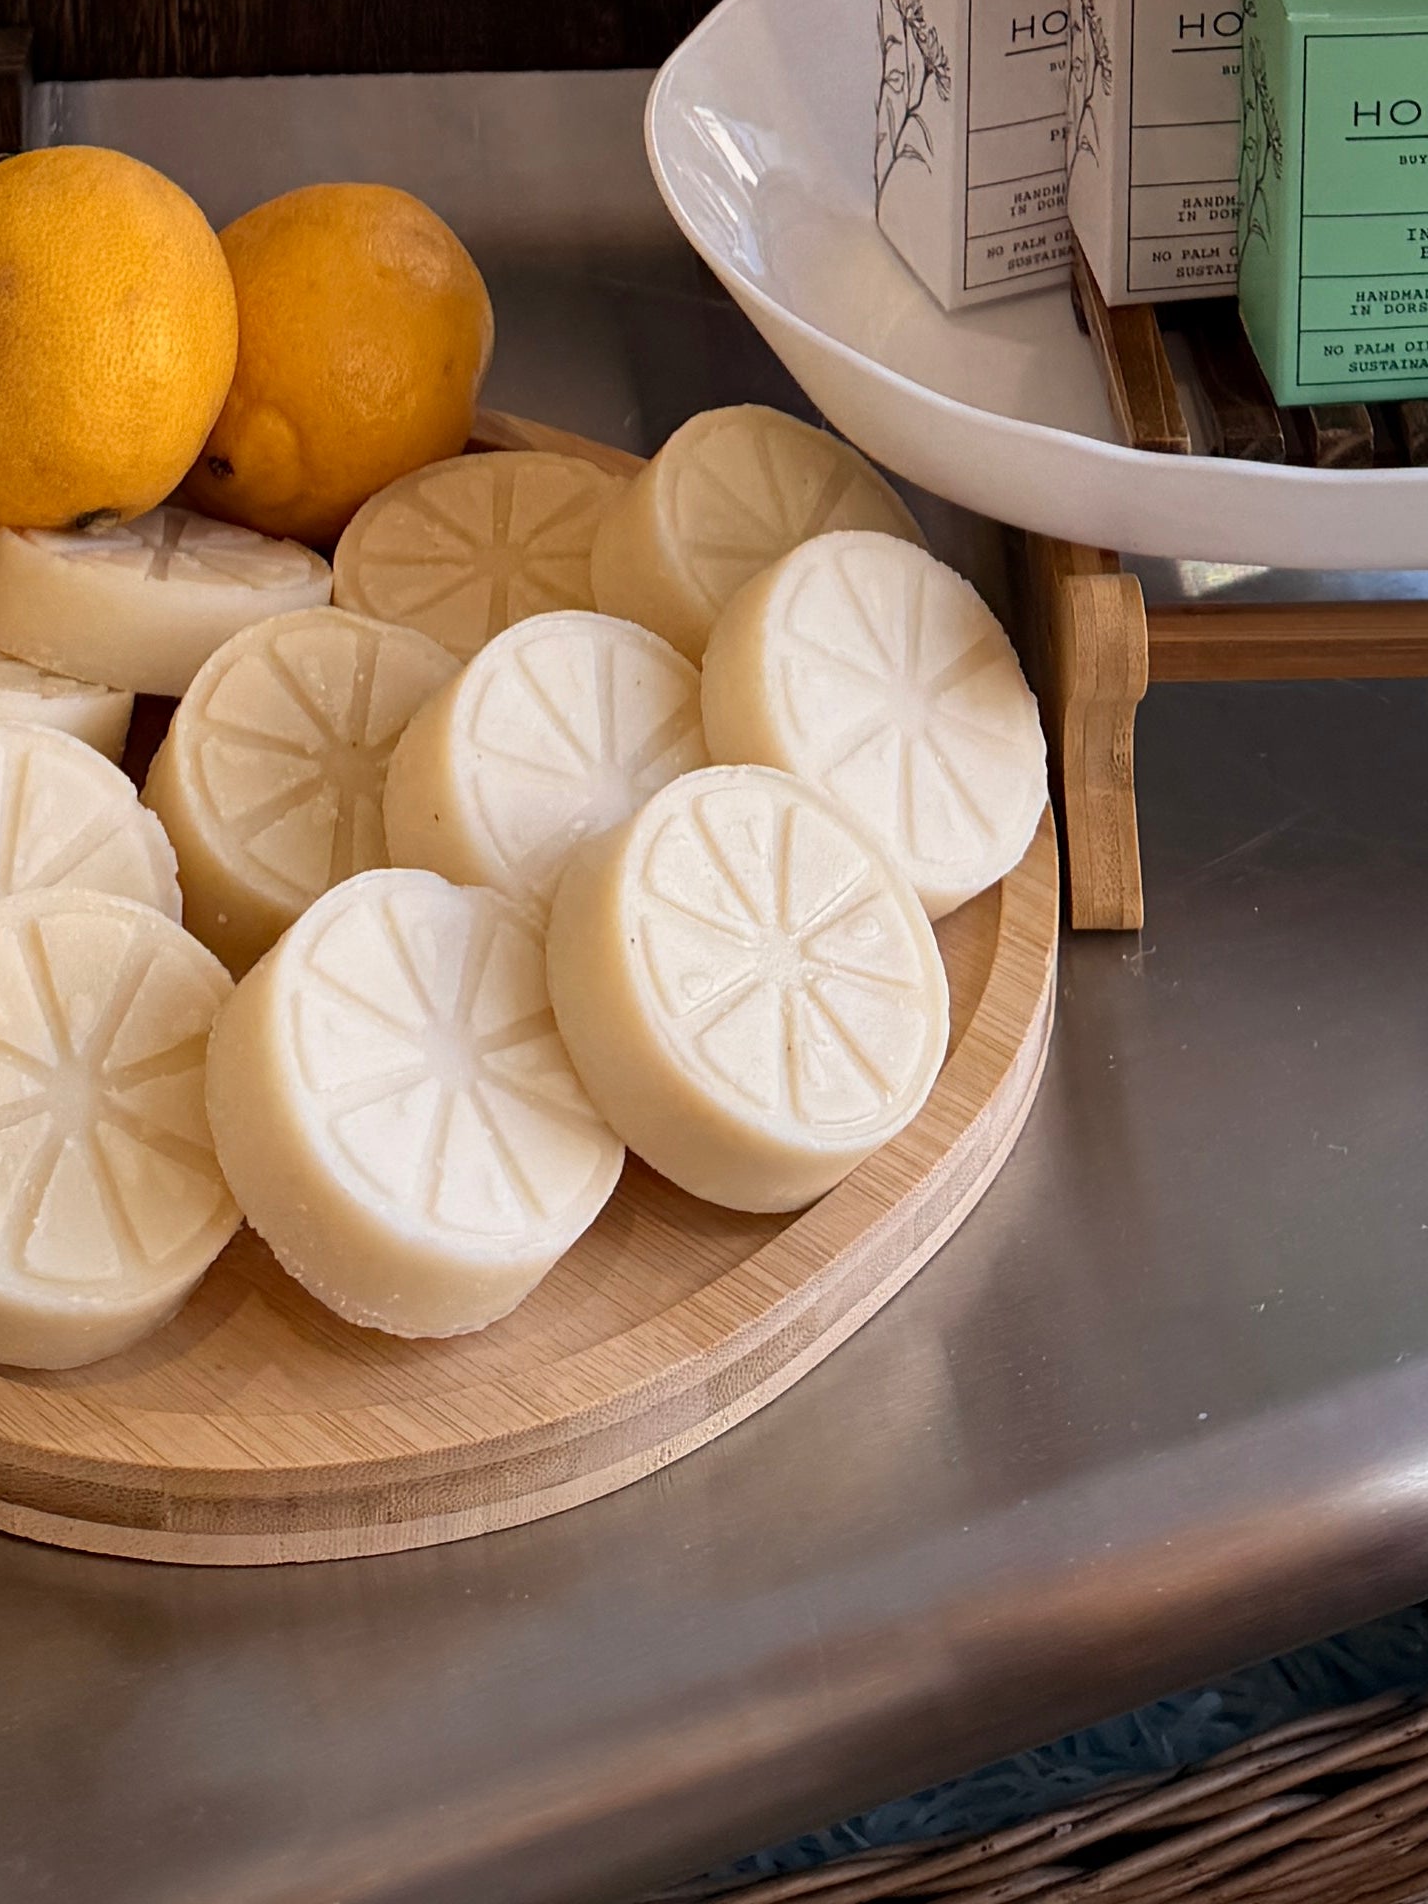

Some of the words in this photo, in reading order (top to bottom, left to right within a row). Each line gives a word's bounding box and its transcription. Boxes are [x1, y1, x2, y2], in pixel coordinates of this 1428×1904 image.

[1399, 153, 1428, 165] BUY
[1350, 304, 1371, 316] IN
[1323, 345, 1344, 356] NO
[1354, 343, 1395, 355] PALM
